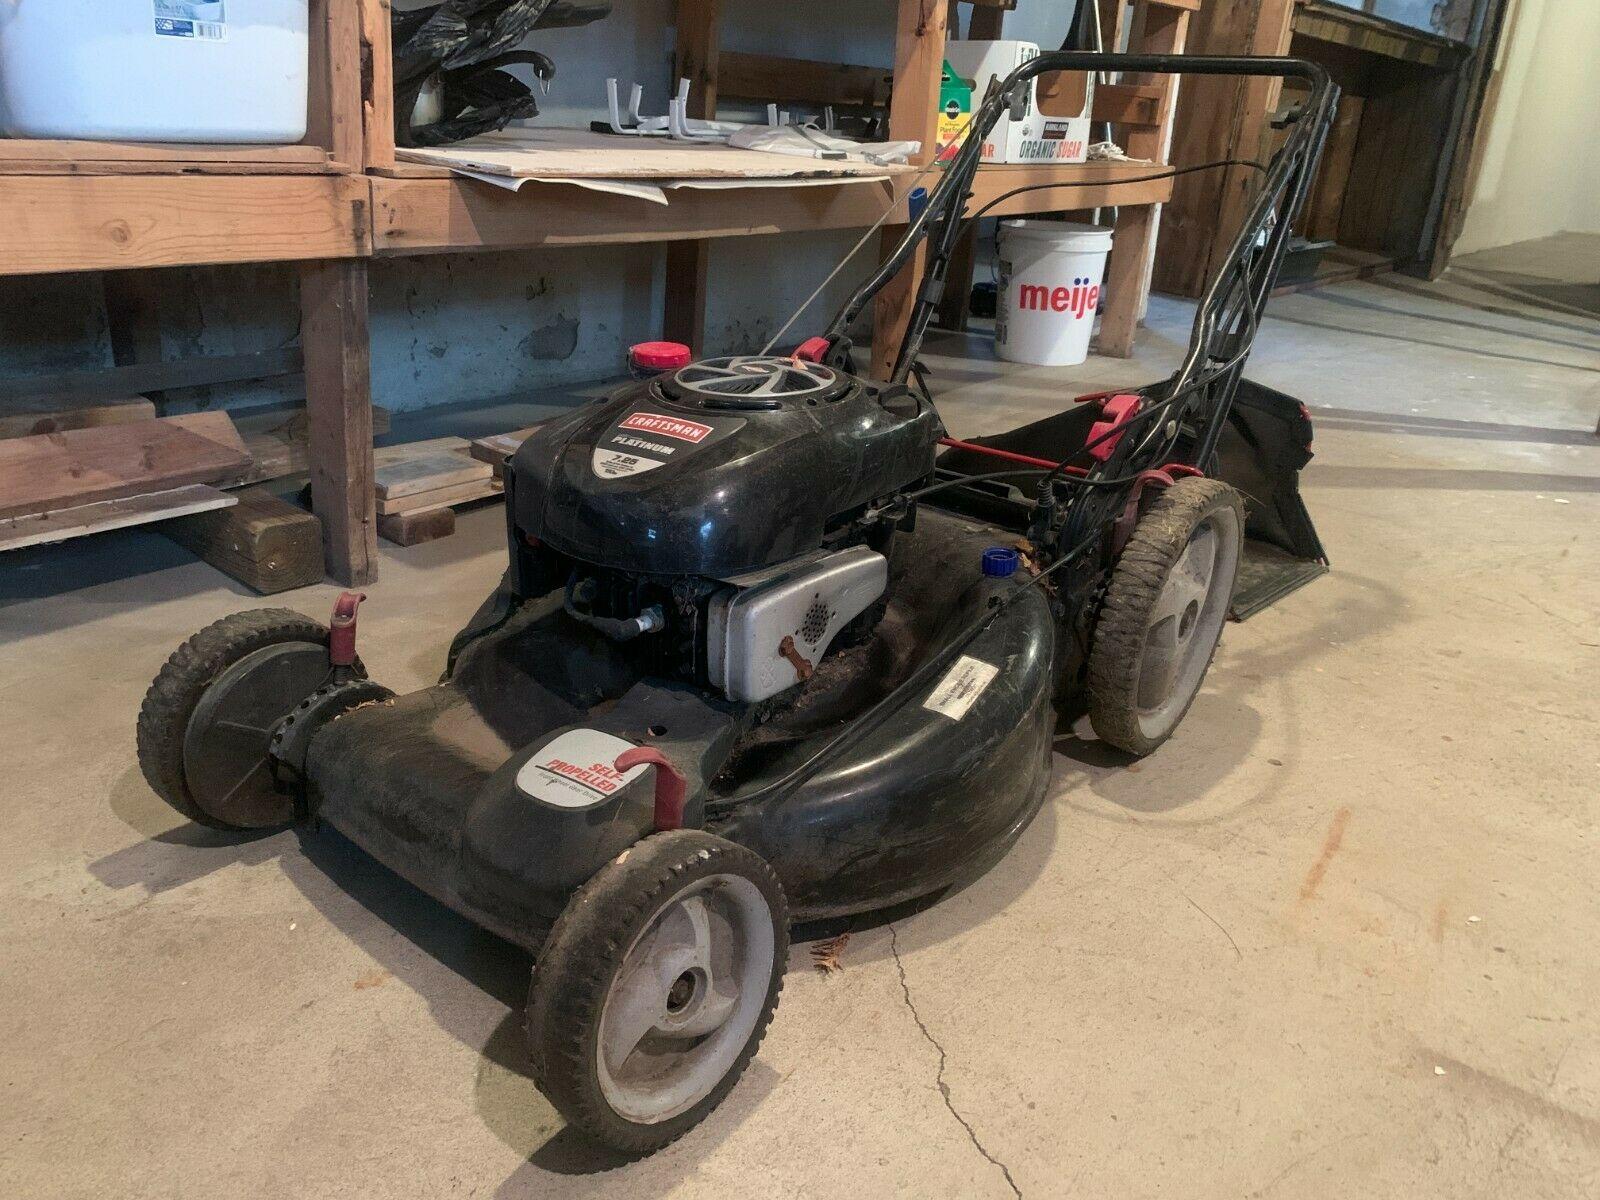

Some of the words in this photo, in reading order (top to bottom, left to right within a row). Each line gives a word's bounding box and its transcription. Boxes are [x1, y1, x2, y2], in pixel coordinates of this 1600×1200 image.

[1019, 140, 1057, 158] ORGANIC
[1056, 141, 1082, 158] SUGAR
[1019, 278, 1099, 319] meije
[627, 416, 703, 438] CRAFTSMAN
[611, 435, 676, 455] PLATINUM
[545, 759, 617, 792] PROPELLED
